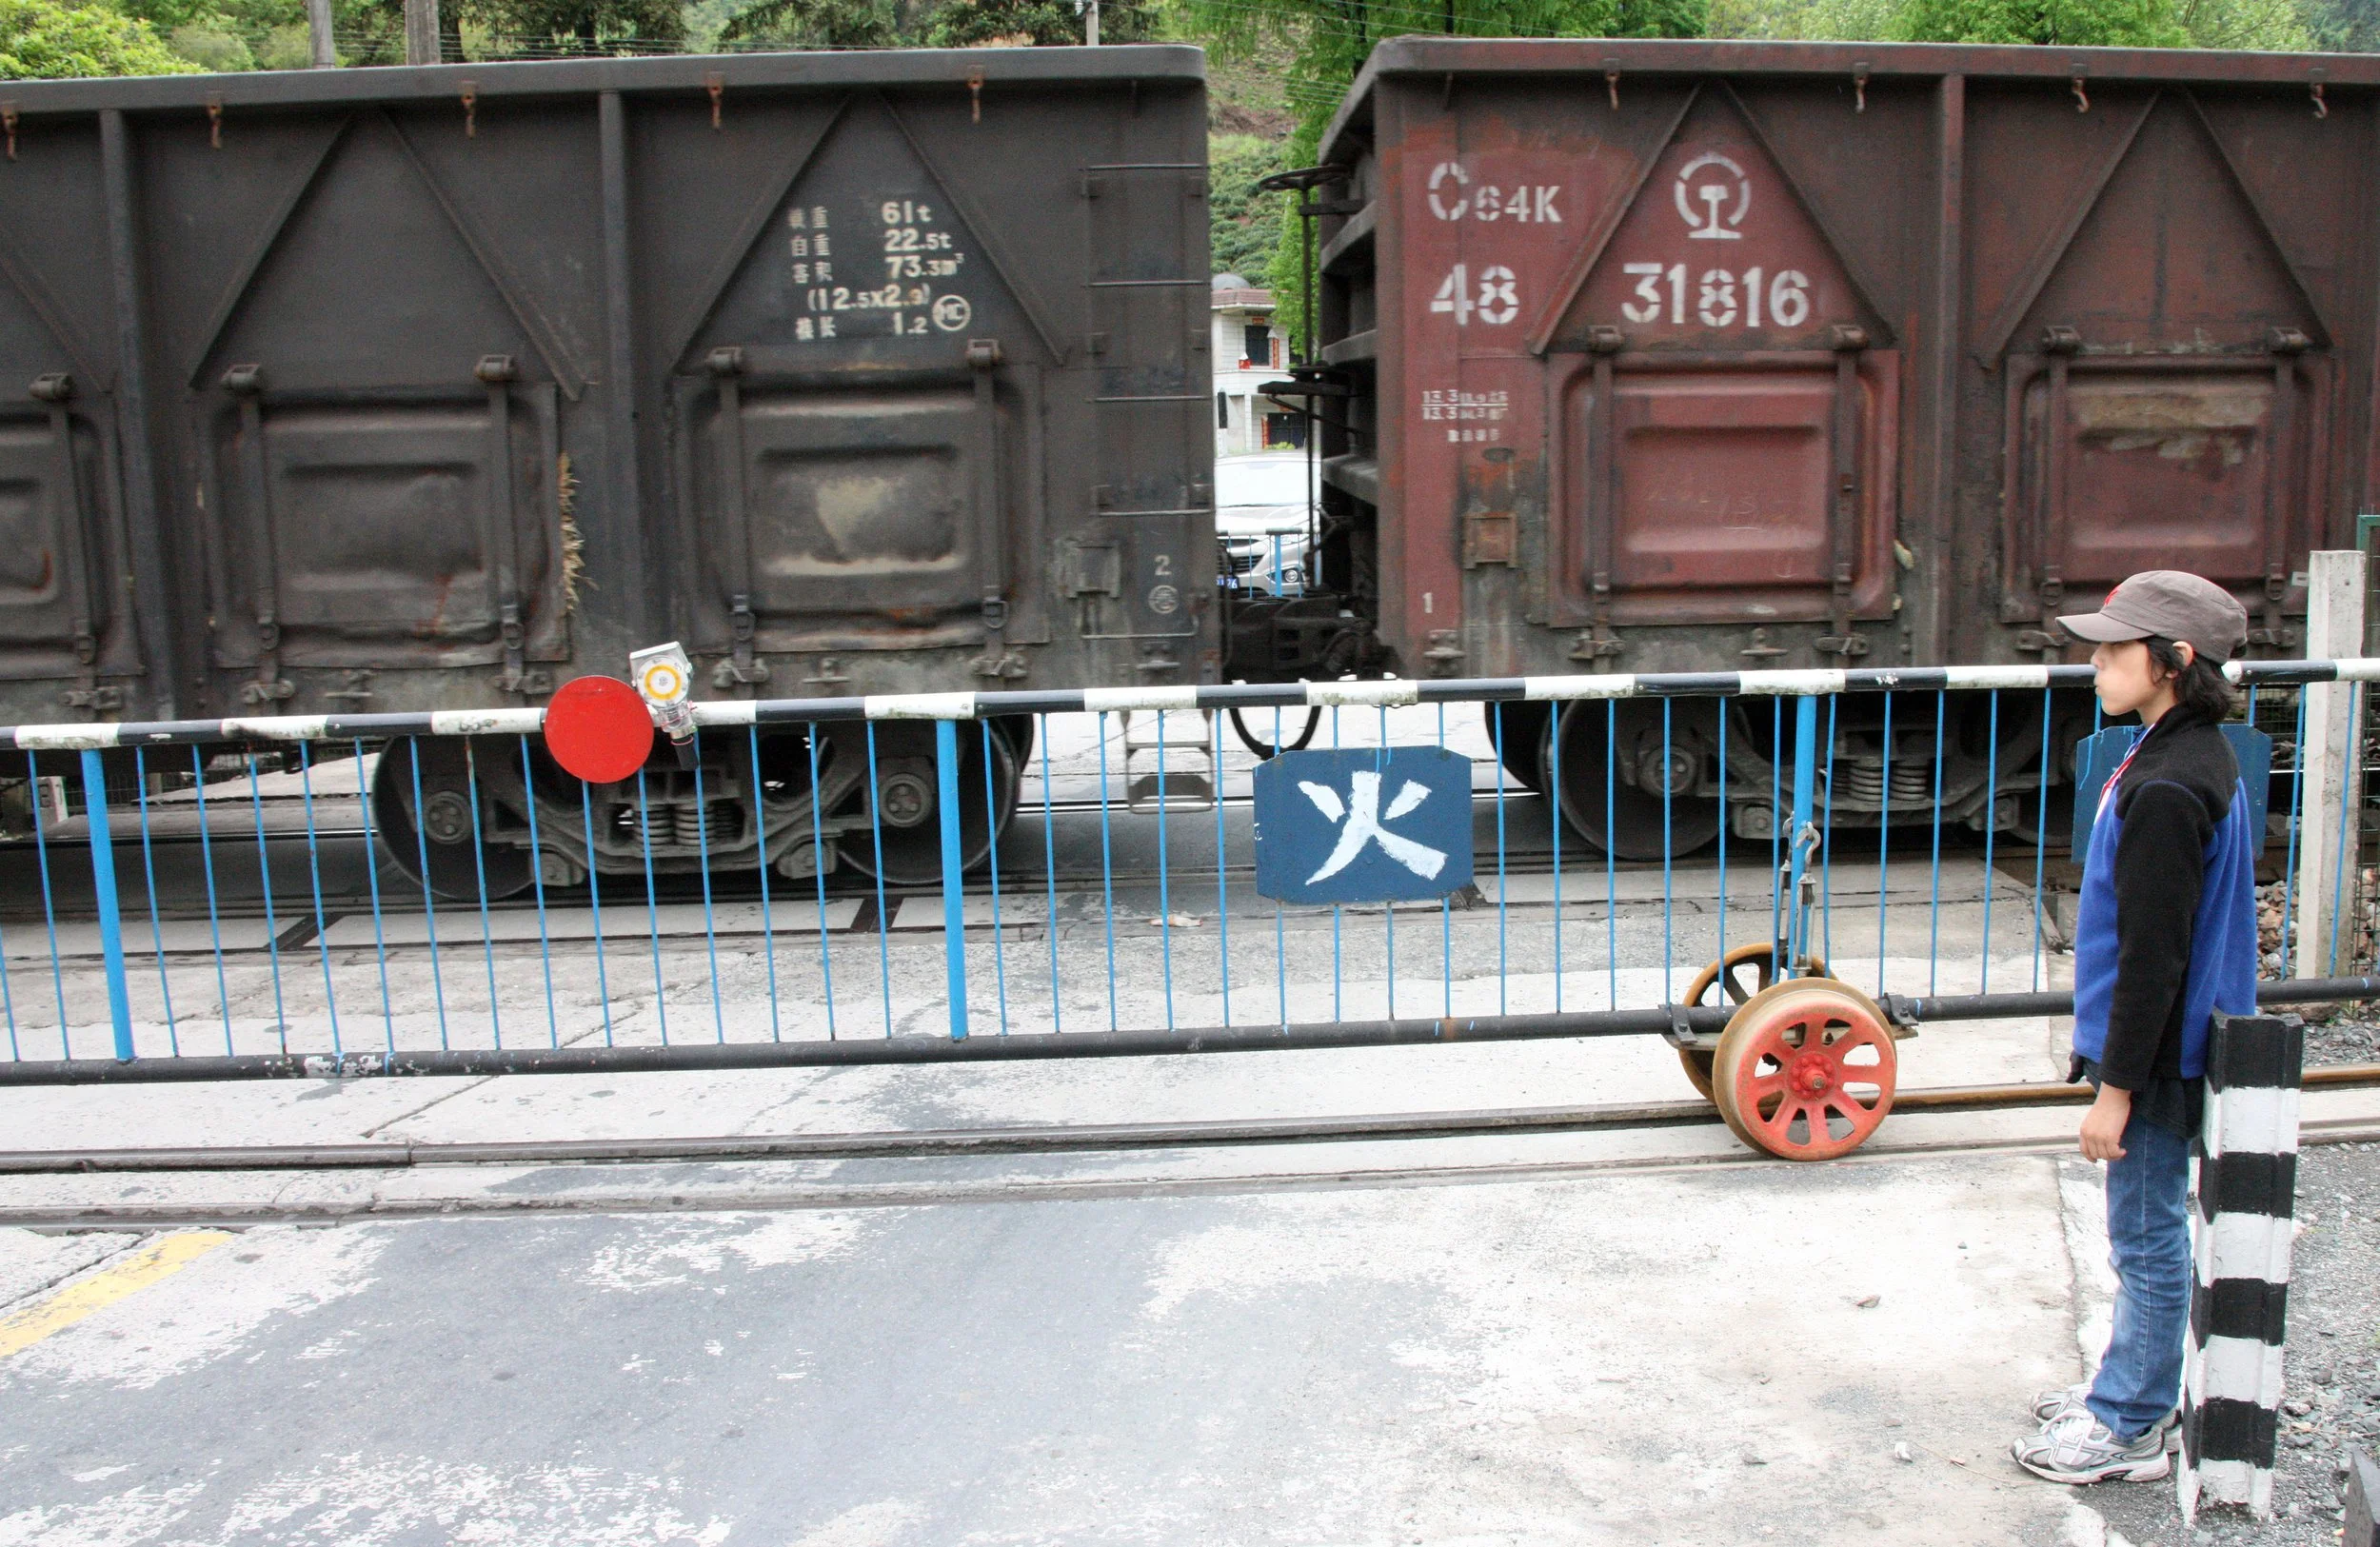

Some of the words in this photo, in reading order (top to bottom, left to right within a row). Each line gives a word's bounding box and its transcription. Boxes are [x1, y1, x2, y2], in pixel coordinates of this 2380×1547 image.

[1429, 162, 1562, 223] C64K
[882, 200, 933, 225] 61t
[884, 228, 952, 252] 22.5t
[1430, 264, 1519, 327] 48
[1621, 262, 1809, 327] 31816
[1155, 554, 1172, 576] 2
[1422, 592, 1433, 614] 1
[1297, 770, 1449, 886] 火
